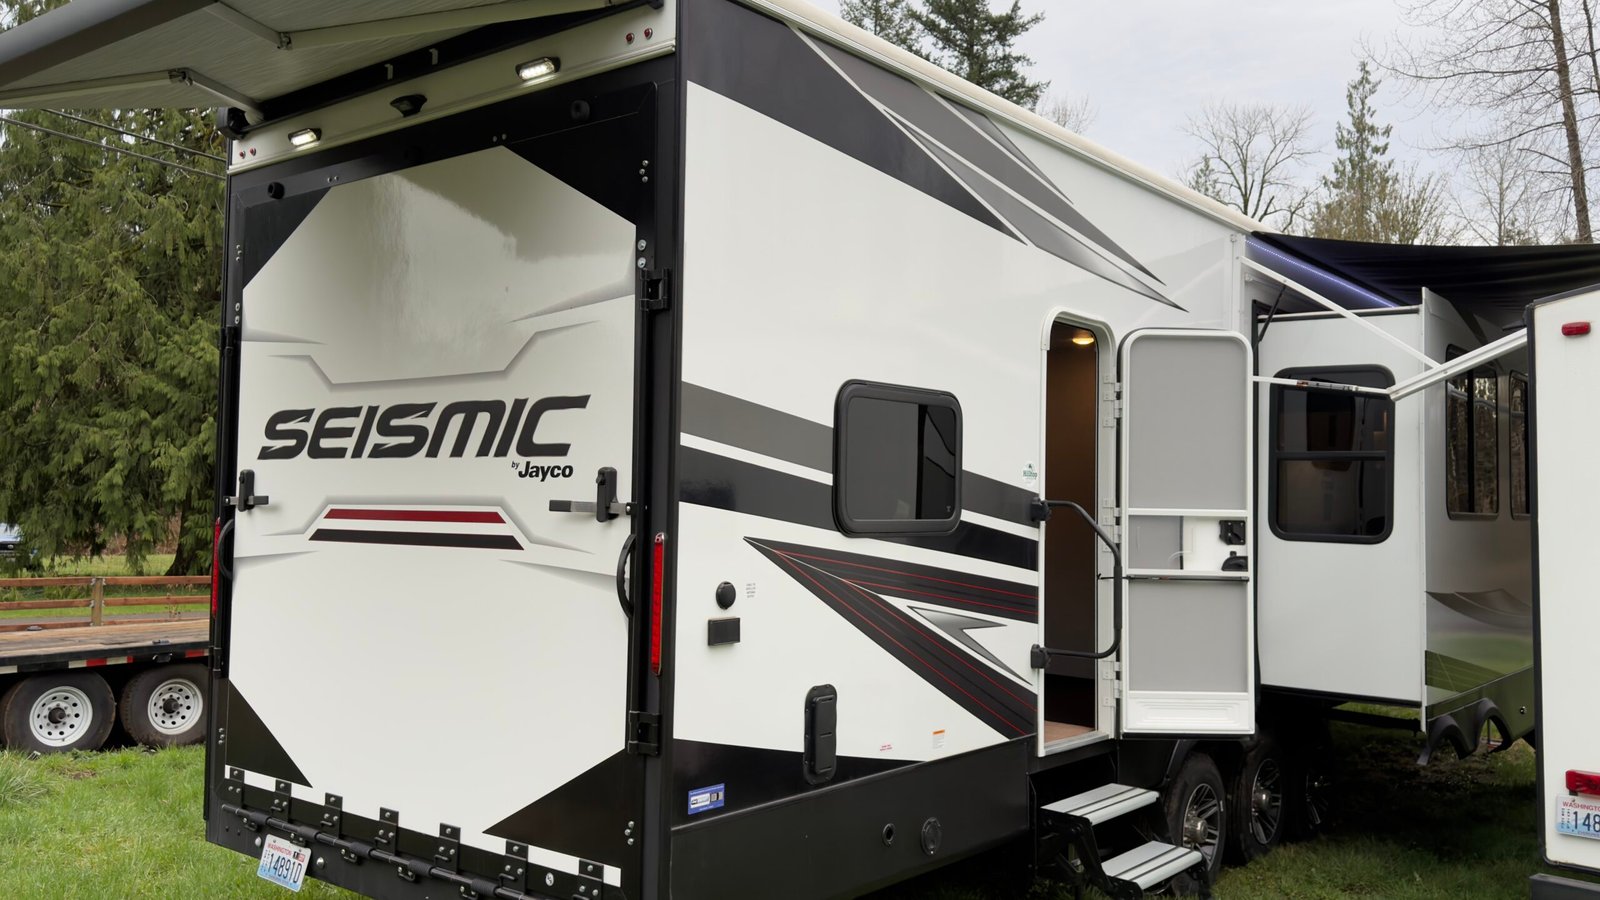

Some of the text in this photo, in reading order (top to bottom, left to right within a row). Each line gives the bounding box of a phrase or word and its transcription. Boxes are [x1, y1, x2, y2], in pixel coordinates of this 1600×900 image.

[257, 394, 591, 460] SEISMIC
[511, 461, 574, 482] by Jayco
